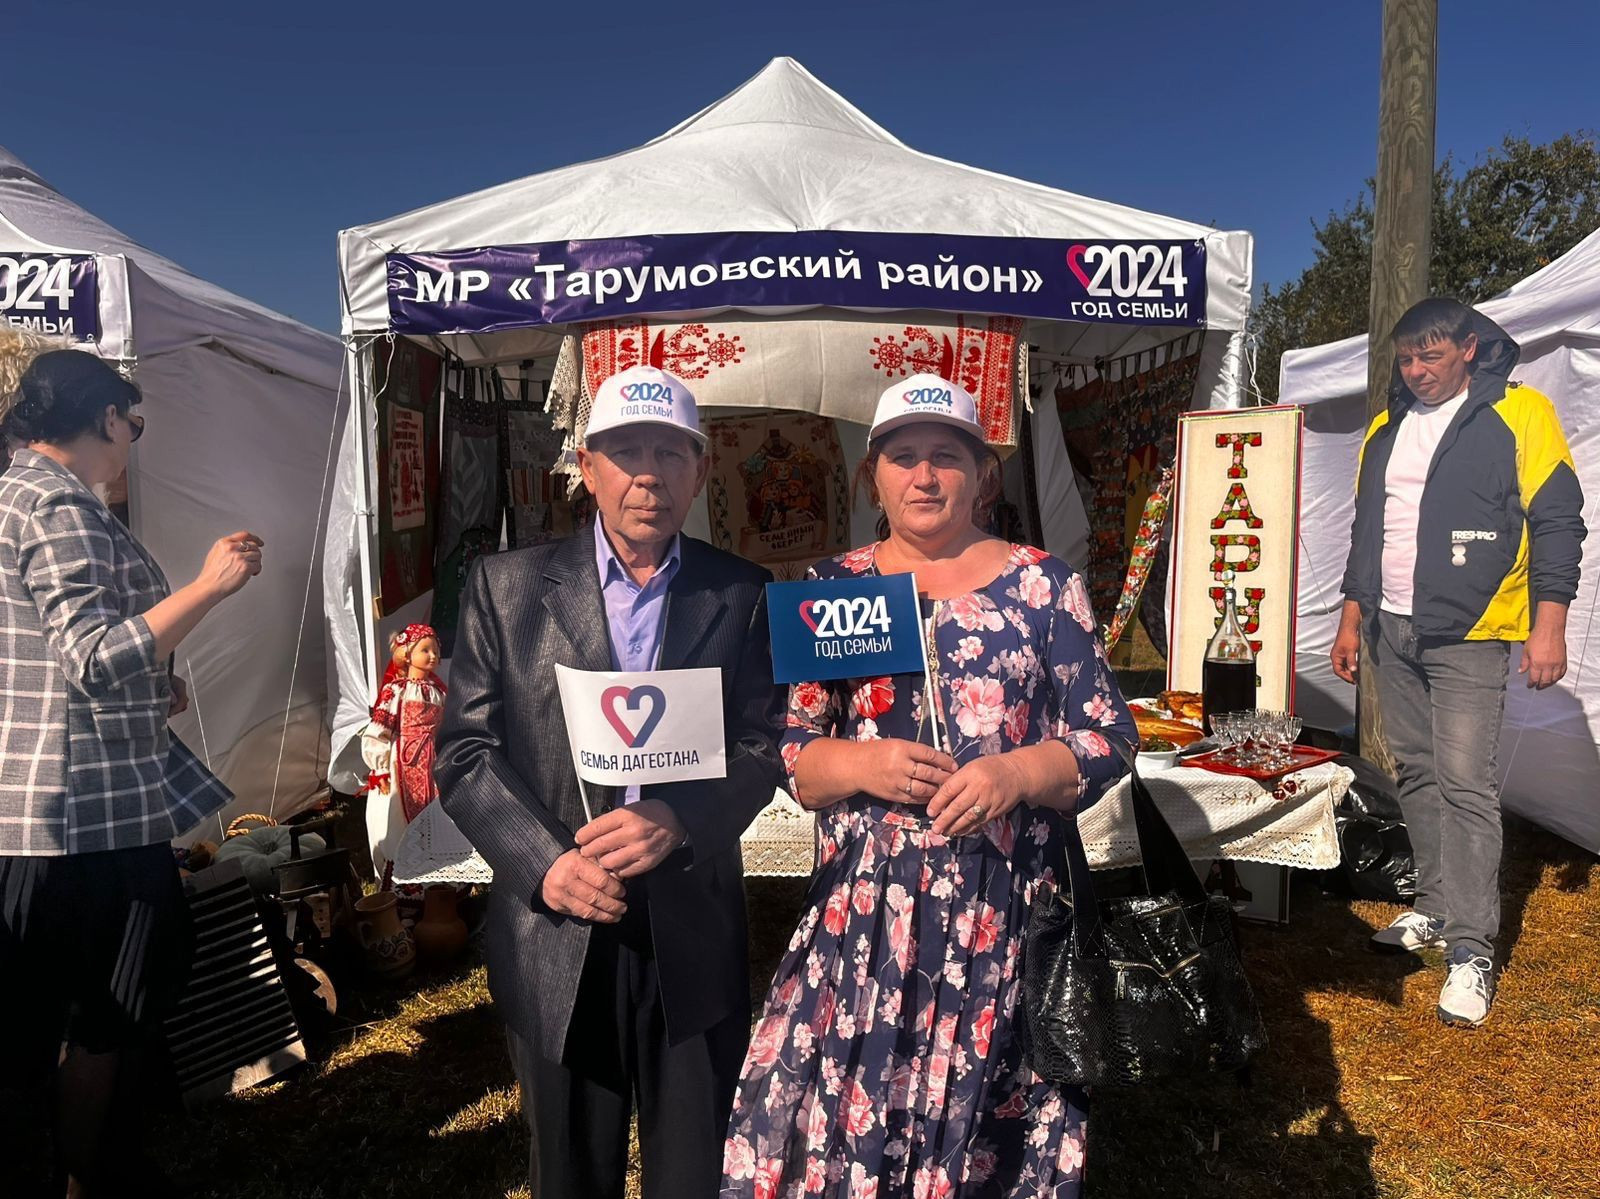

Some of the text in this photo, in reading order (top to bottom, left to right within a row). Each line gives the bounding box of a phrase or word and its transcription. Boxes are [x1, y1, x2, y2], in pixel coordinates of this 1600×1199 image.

[415, 248, 1044, 304] МР «Тарумовский район»
[1083, 244, 1188, 297] 2024
[0, 256, 74, 311] 024
[1070, 302, 1188, 319] ГОД СЕМЬИ
[8, 315, 74, 334] ЕМЬИ
[627, 382, 674, 405] 2024
[910, 387, 953, 407] 2024
[621, 404, 673, 419] ГОД СЕМЬИ
[1208, 432, 1266, 688] ТАРУ
[812, 595, 892, 638] 2024
[814, 640, 842, 659] ГОД
[580, 750, 700, 771] СЕМЬЯ ДАГЕСТАНА
